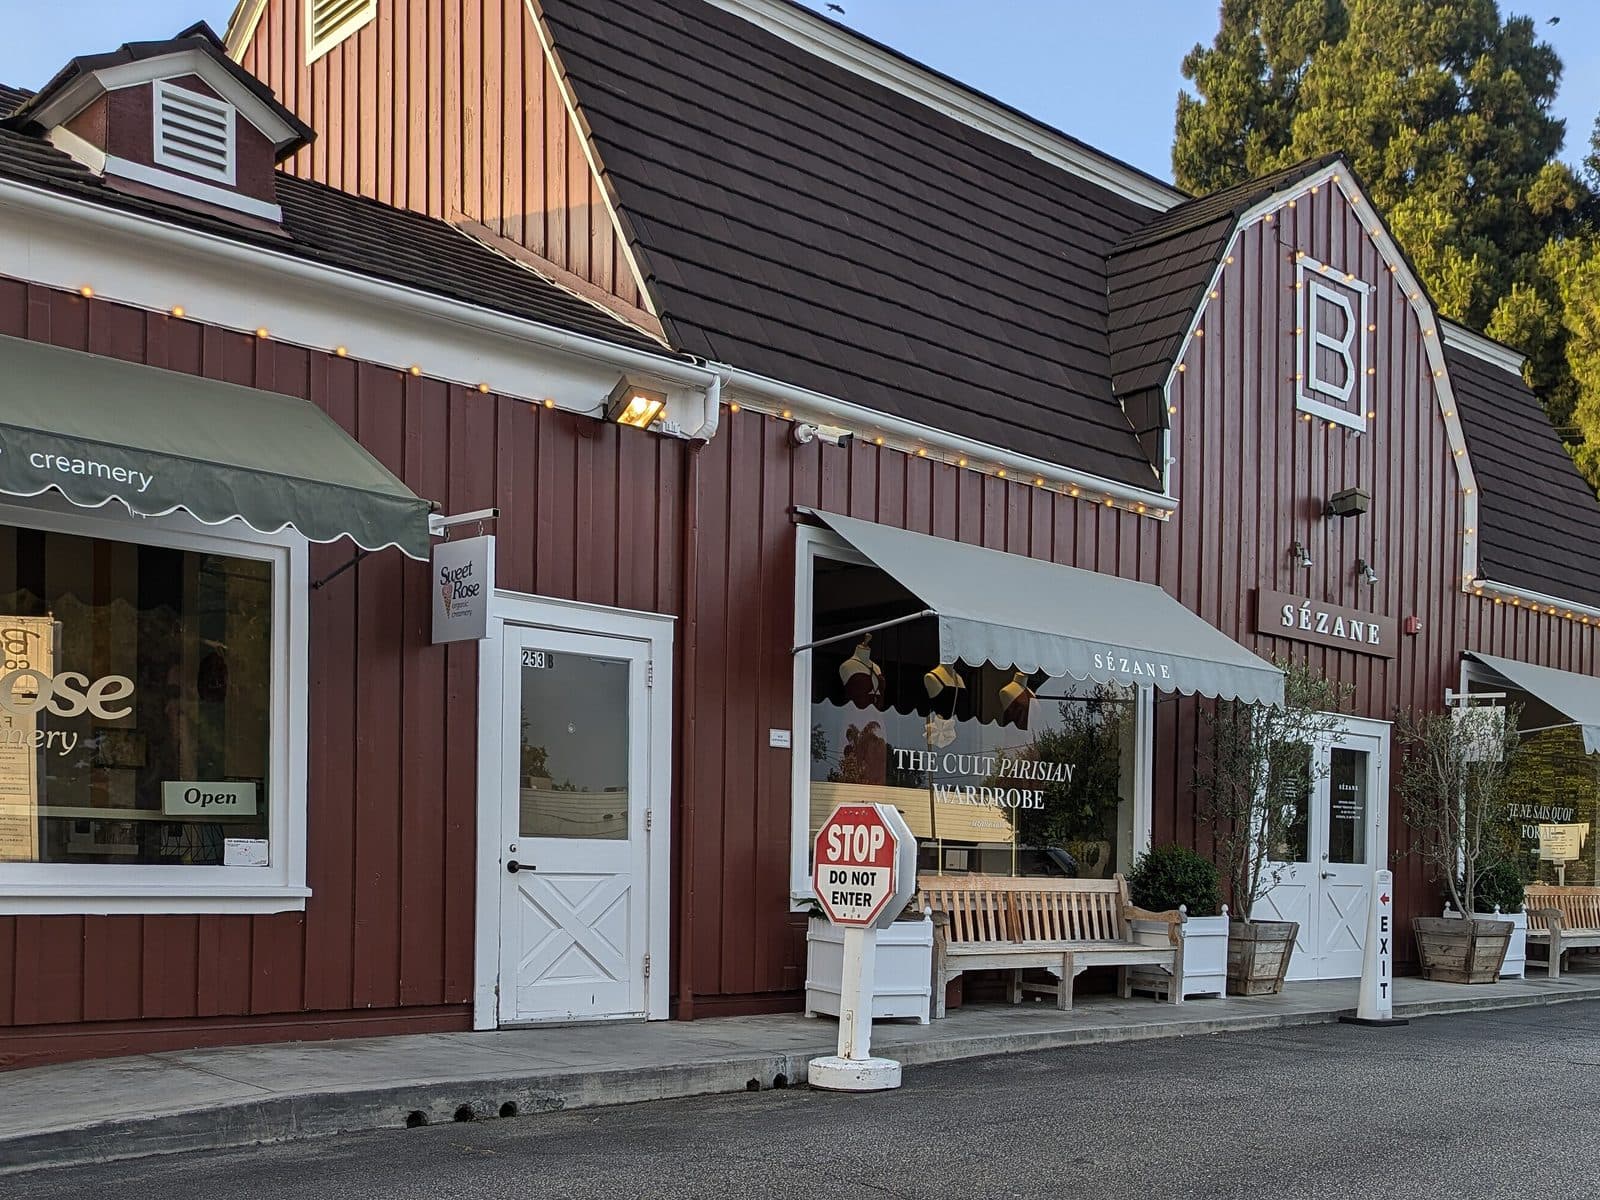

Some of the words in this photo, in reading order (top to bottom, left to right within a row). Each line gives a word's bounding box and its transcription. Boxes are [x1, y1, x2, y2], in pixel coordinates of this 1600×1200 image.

[1309, 279, 1356, 402] B
[29, 452, 154, 492] creamery
[440, 560, 473, 586] Sweet
[452, 580, 480, 600] Rose
[1281, 600, 1380, 645] SÉZANE
[522, 651, 543, 667] 253
[548, 655, 554, 668] B
[1094, 651, 1170, 679] SÉZANE
[893, 748, 938, 772] THE
[942, 753, 995, 777] CULT
[999, 758, 1076, 783] PARISIAN
[184, 788, 237, 807] Open
[933, 783, 1045, 810] WARDROBE
[826, 823, 885, 863] STOP
[829, 870, 848, 885] DO
[851, 871, 877, 886] NOT
[831, 891, 872, 907] ENTER
[1380, 916, 1389, 999] EXIT
